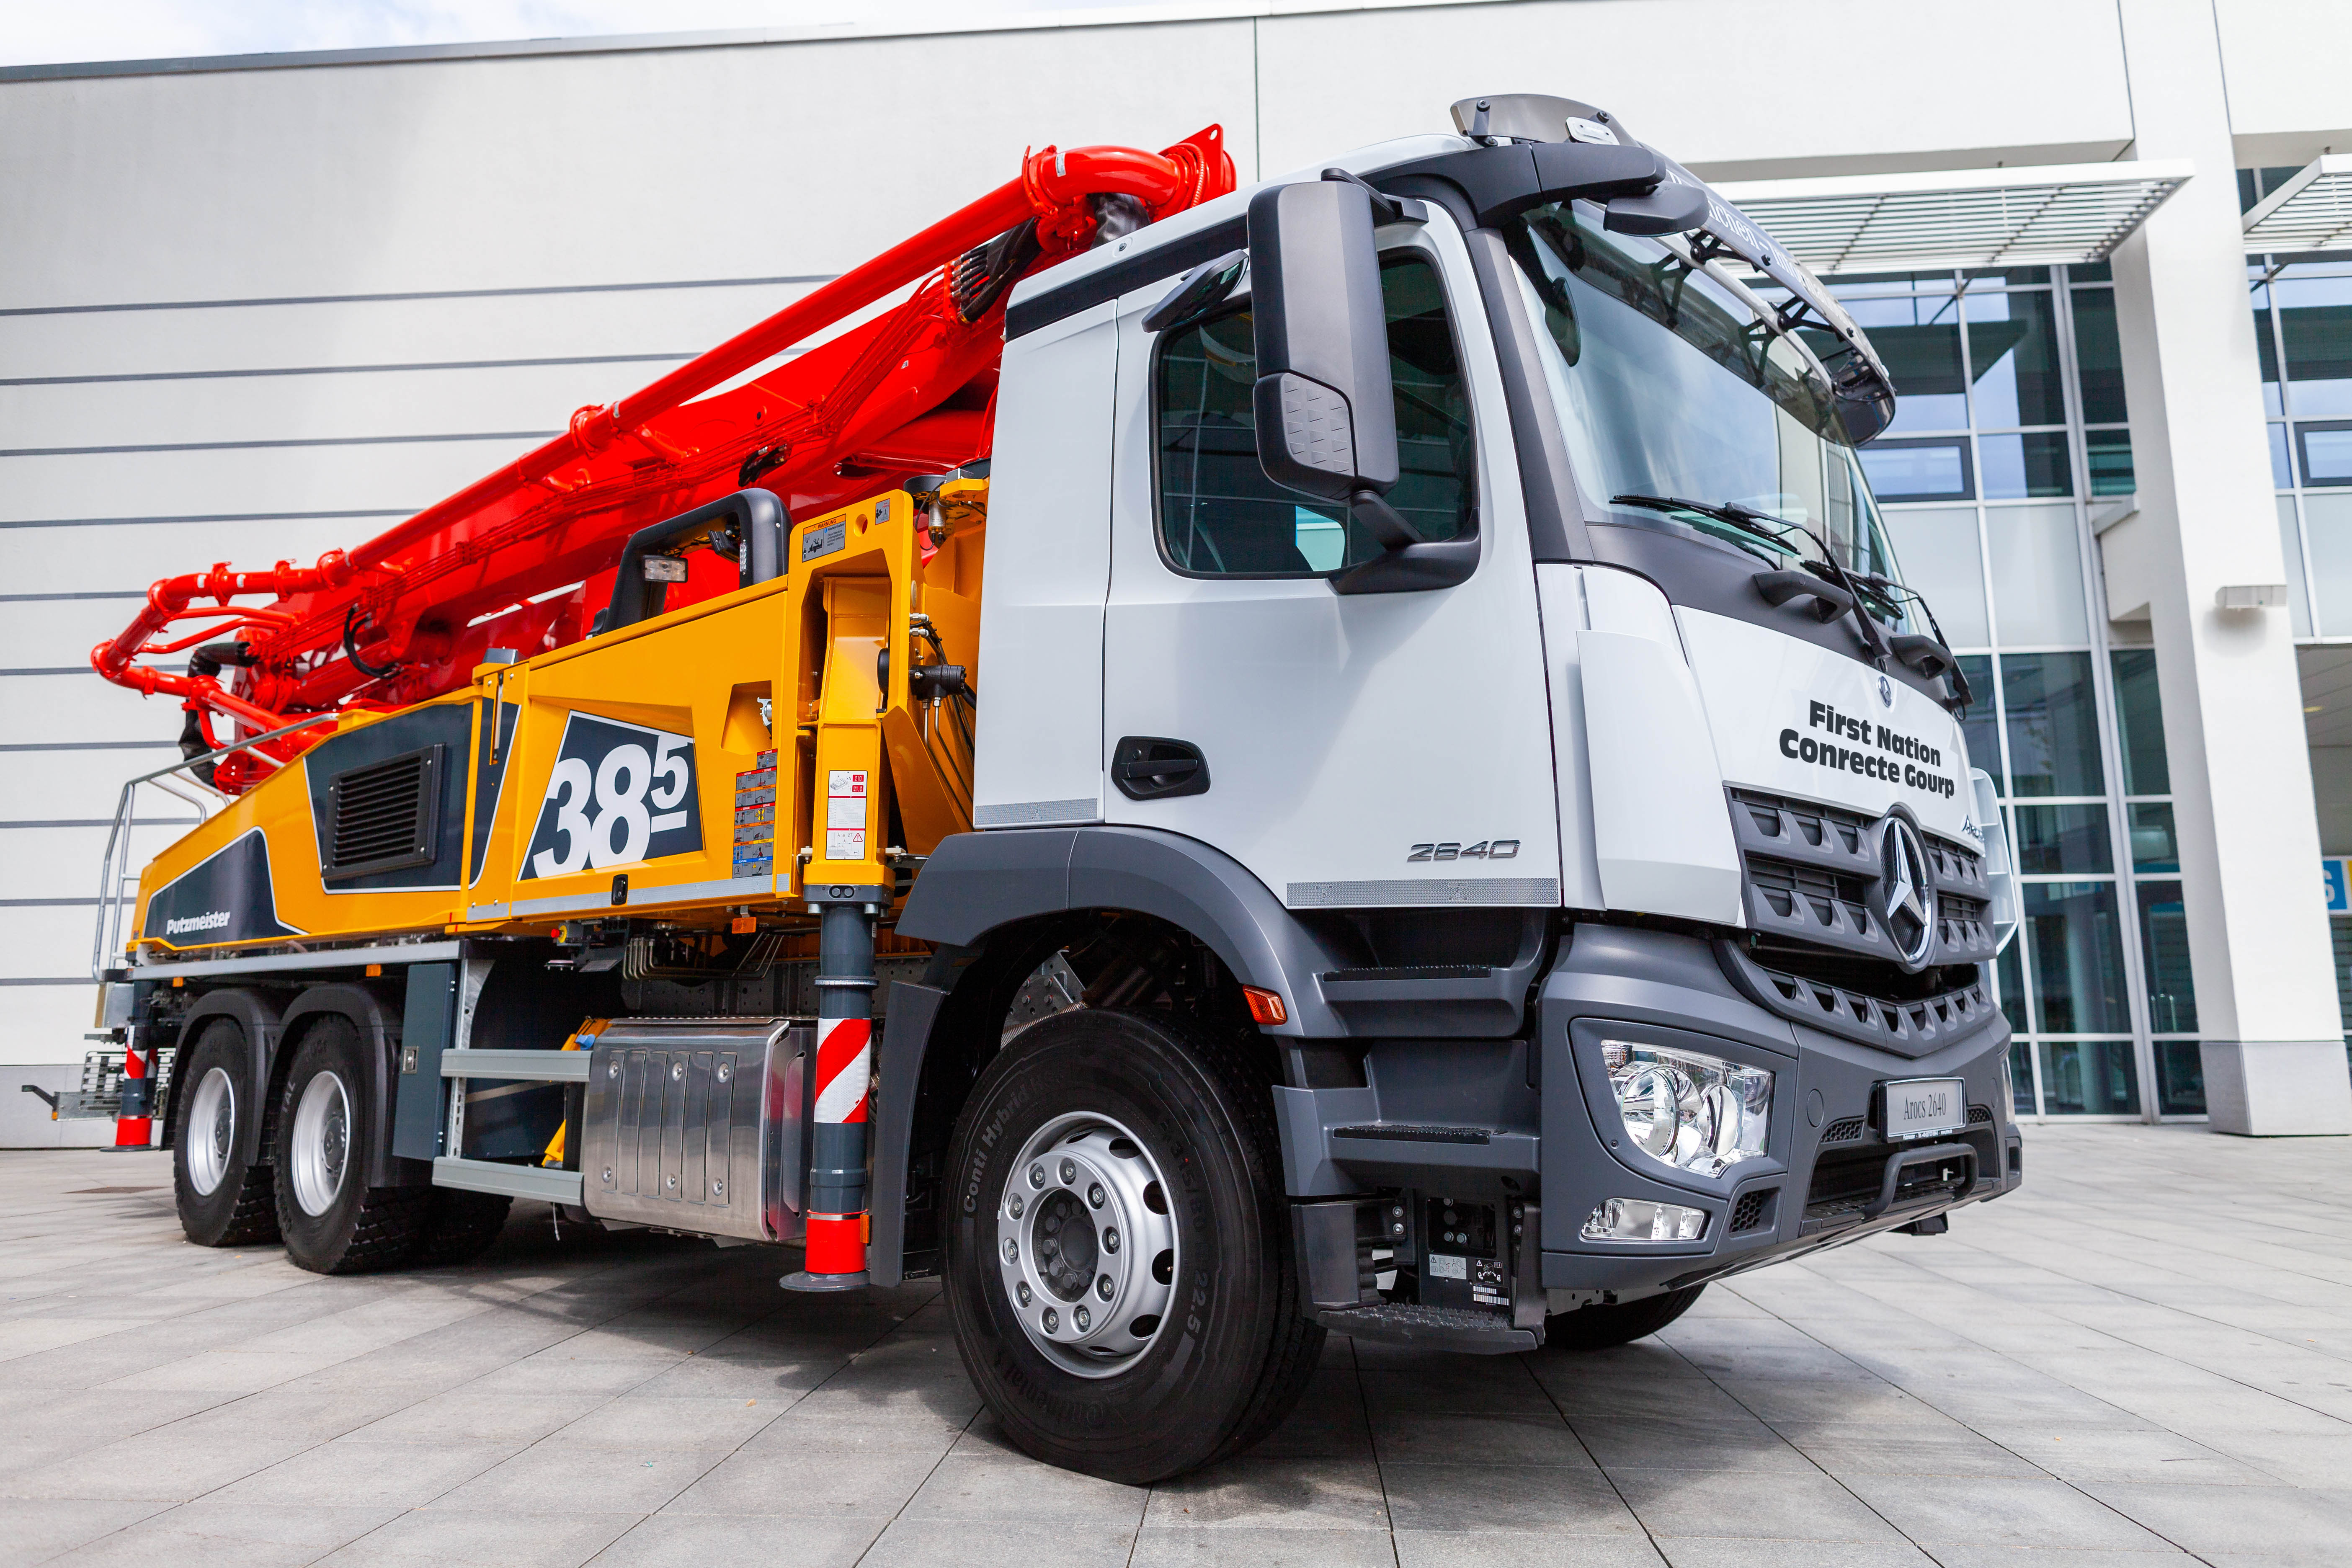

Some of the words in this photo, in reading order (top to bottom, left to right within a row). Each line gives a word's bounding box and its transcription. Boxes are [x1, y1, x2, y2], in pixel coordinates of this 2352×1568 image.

[818, 519, 836, 529] WARNUNG
[1809, 699, 1871, 745] First
[1877, 724, 1941, 767] Nation
[1779, 728, 1900, 783] Conrecte
[1904, 763, 1955, 799] Gourp
[1407, 840, 1521, 861] 2640
[166, 910, 230, 935] Putzmeister
[1904, 1096, 1926, 1120] Arocs
[1928, 1092, 1946, 1117] 2640
[963, 1148, 988, 1213] Conti
[982, 1083, 1030, 1148] Hybrid
[1187, 1269, 1209, 1333] 22.5
